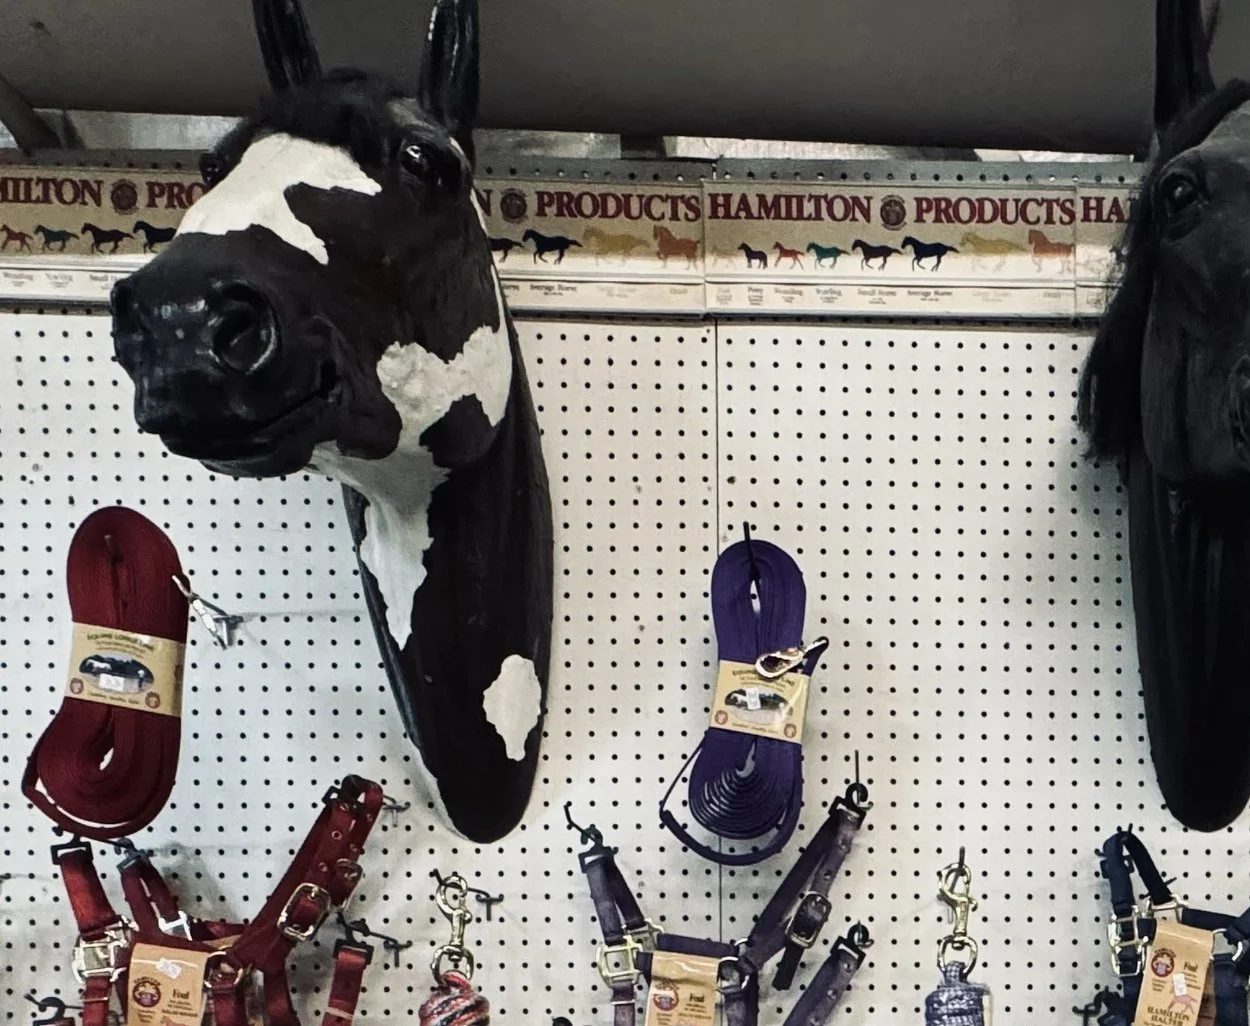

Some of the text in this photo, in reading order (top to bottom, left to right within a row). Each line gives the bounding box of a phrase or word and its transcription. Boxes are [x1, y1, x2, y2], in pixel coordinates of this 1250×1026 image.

[0, 176, 104, 208] ILTON
[535, 190, 701, 222] PRODUCTS
[708, 191, 873, 223] HAMILTON
[913, 195, 1076, 226] PRODUCTS
